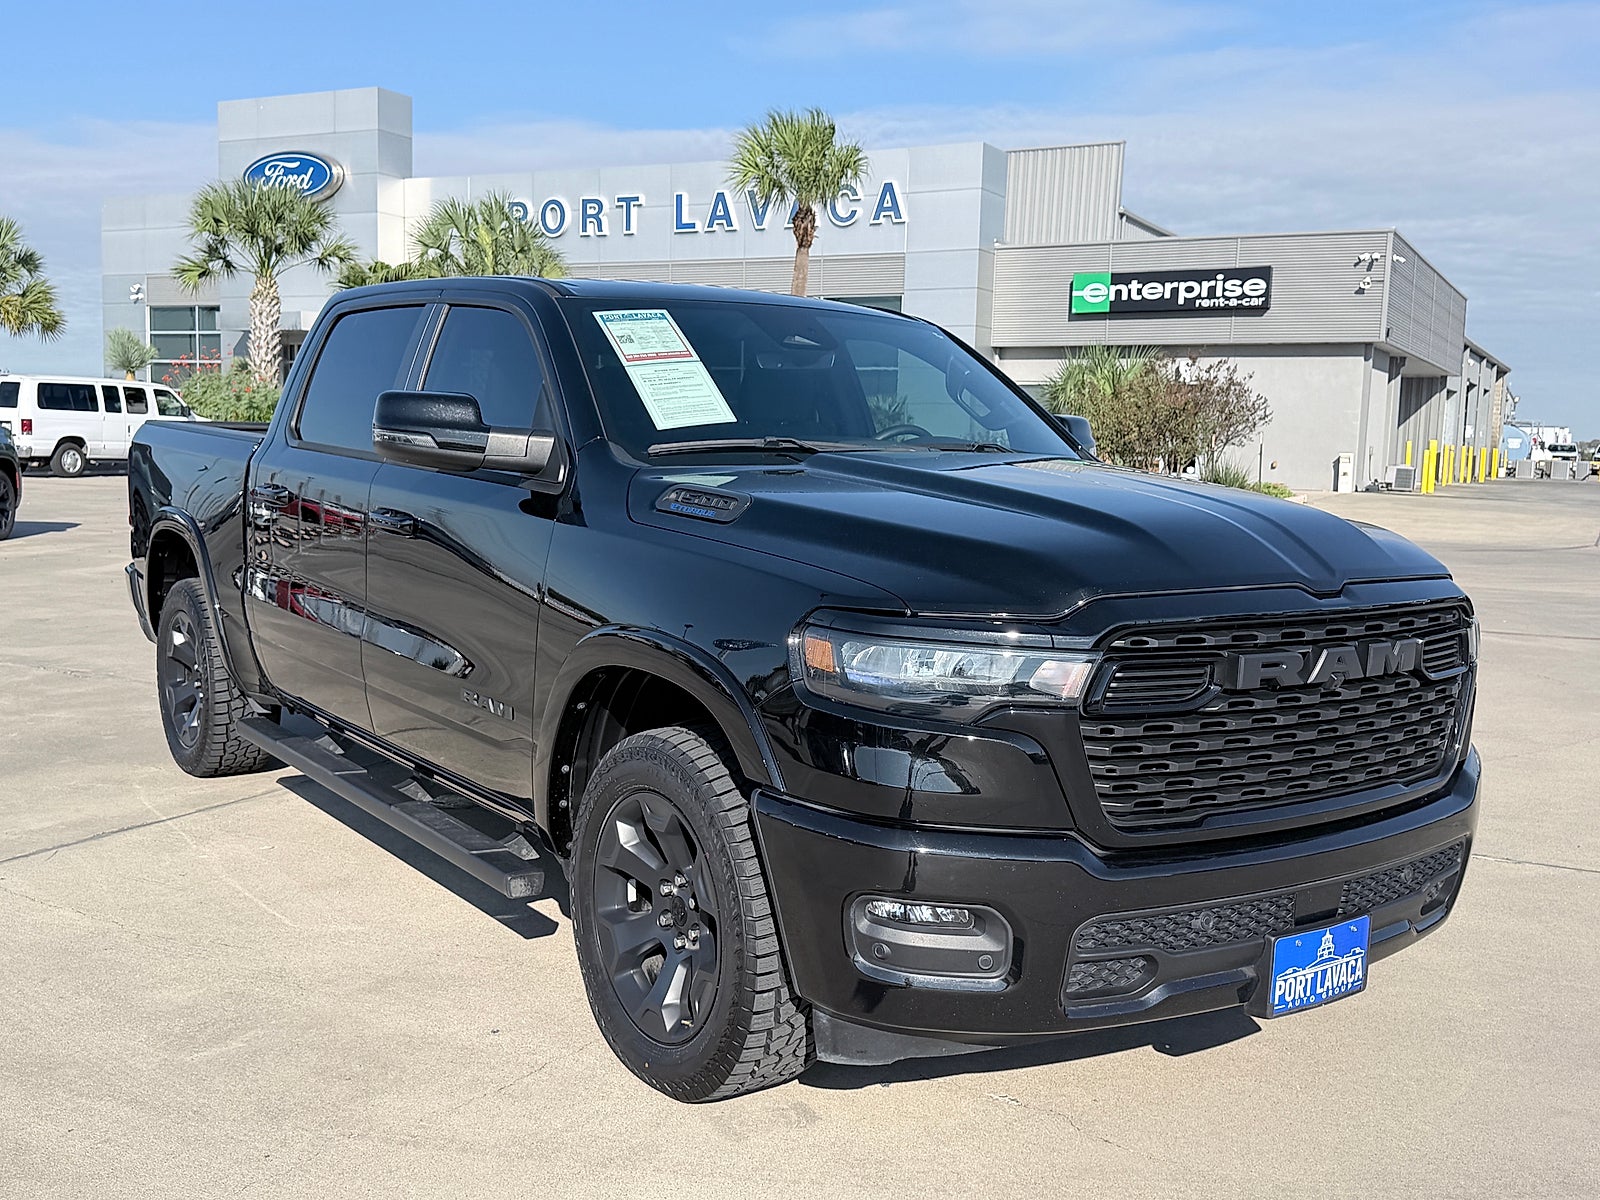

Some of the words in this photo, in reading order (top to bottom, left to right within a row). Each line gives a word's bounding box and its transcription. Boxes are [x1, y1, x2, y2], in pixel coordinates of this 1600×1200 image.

[261, 161, 315, 191] Ford
[674, 180, 907, 232] LAVCA
[1074, 273, 1267, 305] enterprise
[1195, 296, 1266, 308] rent-a-car
[1236, 637, 1420, 690] RAM
[1274, 972, 1315, 1005] PORT
[1316, 957, 1363, 995] LAVACA
[1287, 995, 1316, 1009] AUTO
[1321, 983, 1353, 999] GROUP
